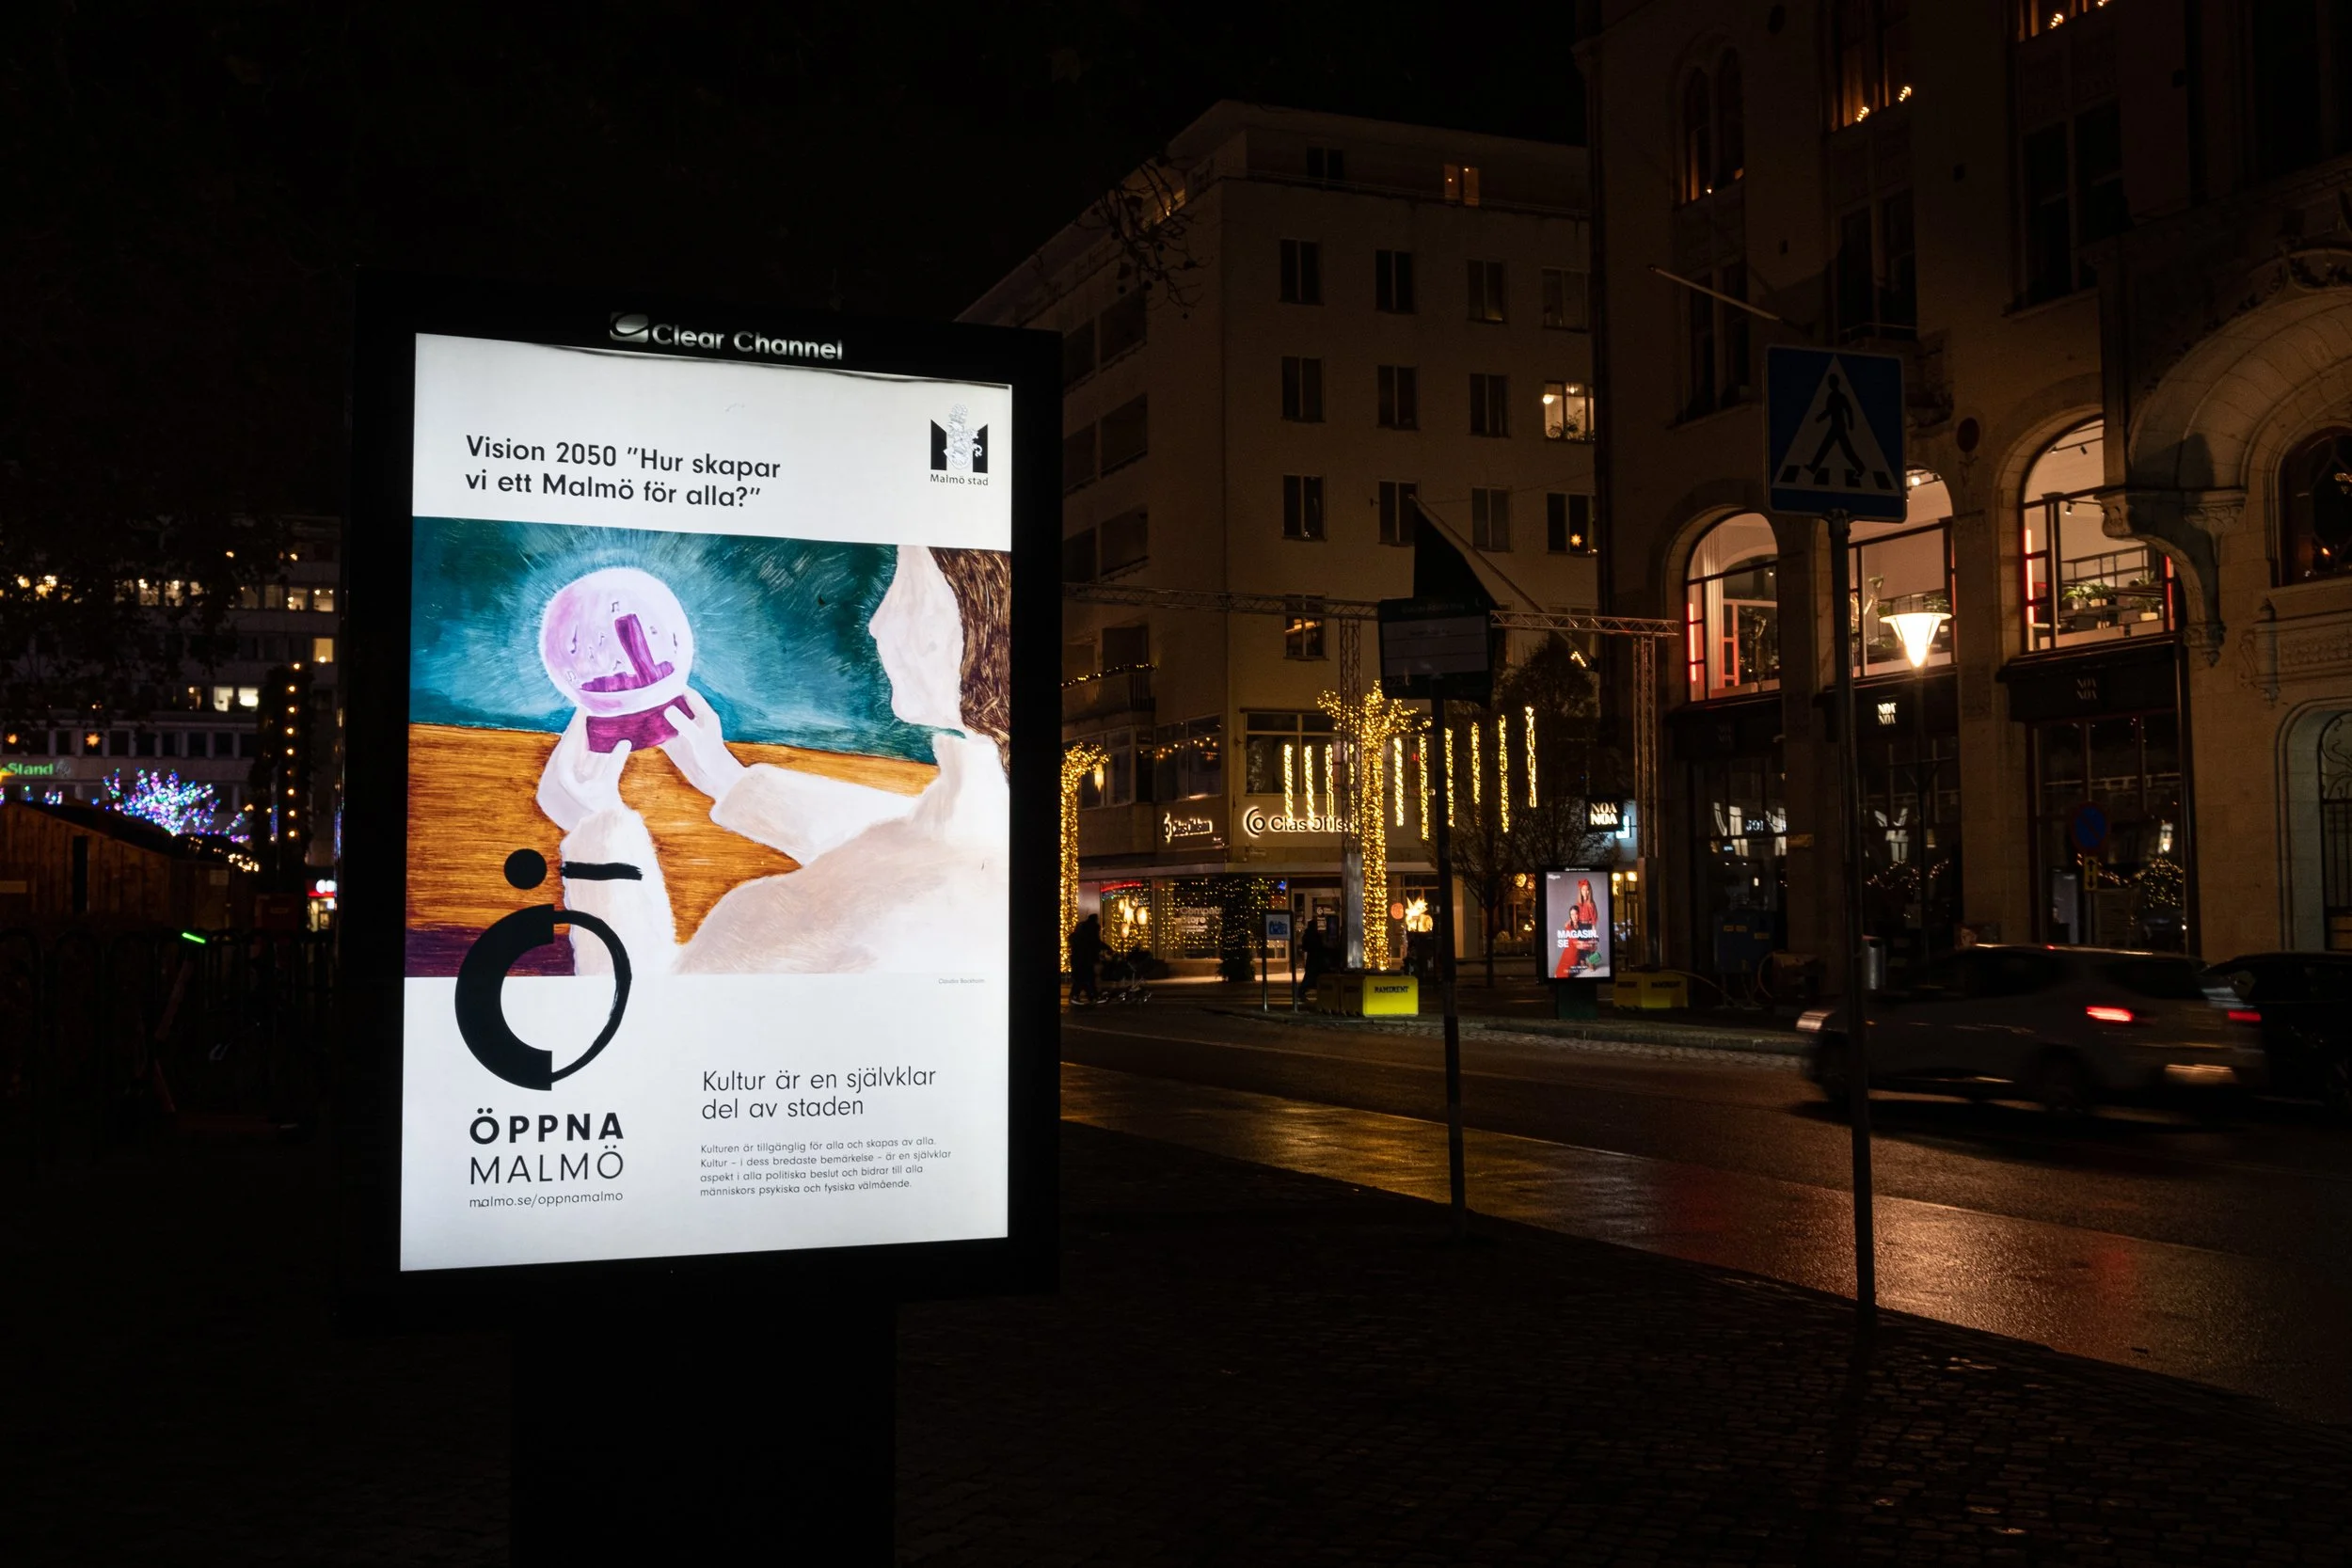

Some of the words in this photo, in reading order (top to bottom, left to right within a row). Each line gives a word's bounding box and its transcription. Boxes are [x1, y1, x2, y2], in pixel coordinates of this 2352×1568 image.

[652, 324, 724, 349] Clear
[734, 331, 843, 360] Channel
[466, 436, 545, 461] Vision
[556, 442, 617, 467] 2050
[692, 453, 781, 480] skapar
[465, 470, 487, 490] vi
[498, 473, 532, 494] ett
[543, 473, 634, 500] Malmö
[644, 480, 676, 503] för
[930, 473, 965, 484] Malmö
[967, 477, 989, 485] stad
[1590, 801, 1617, 814] NOA
[1271, 817, 1308, 831] Clas
[1590, 813, 1618, 825] NOA
[1557, 929, 1598, 939] MAGASIN.
[1557, 940, 1568, 948] SE
[704, 1070, 766, 1091] Kultur
[775, 1070, 801, 1090] är
[810, 1073, 837, 1089] en
[847, 1066, 936, 1093] självklar
[702, 1099, 738, 1119] del
[749, 1102, 778, 1117] av
[787, 1096, 864, 1117] staden
[469, 1107, 624, 1145] ÖPPNA
[701, 1144, 739, 1154] Kulturen
[743, 1143, 754, 1152] är
[757, 1141, 806, 1154] tillgänglig
[809, 1141, 823, 1150] för
[826, 1140, 844, 1149] alla
[847, 1139, 864, 1148] och
[866, 1138, 898, 1149] skapas
[916, 1136, 936, 1146] alla.
[470, 1145, 624, 1185] MALMÖ
[701, 1158, 727, 1168] Kultur
[746, 1156, 770, 1166] dess
[772, 1155, 817, 1165] bredaste
[820, 1153, 874, 1164] bemärkelse
[885, 1151, 896, 1161] är
[913, 1149, 951, 1161] självklar
[700, 1172, 734, 1184] aspekt
[742, 1171, 762, 1181] alla
[765, 1169, 806, 1182] politiska
[810, 1168, 839, 1179] beslut
[842, 1167, 858, 1177] och
[861, 1165, 889, 1176] bidrar
[892, 1164, 902, 1174] till
[905, 1164, 923, 1174] alla
[700, 1185, 755, 1196] människors
[758, 1184, 800, 1196] psykiska
[803, 1182, 821, 1193] och
[824, 1181, 855, 1193] fysiska
[858, 1180, 913, 1191] välmående.
[469, 1191, 624, 1208] malmo.se/oppnamalmo
